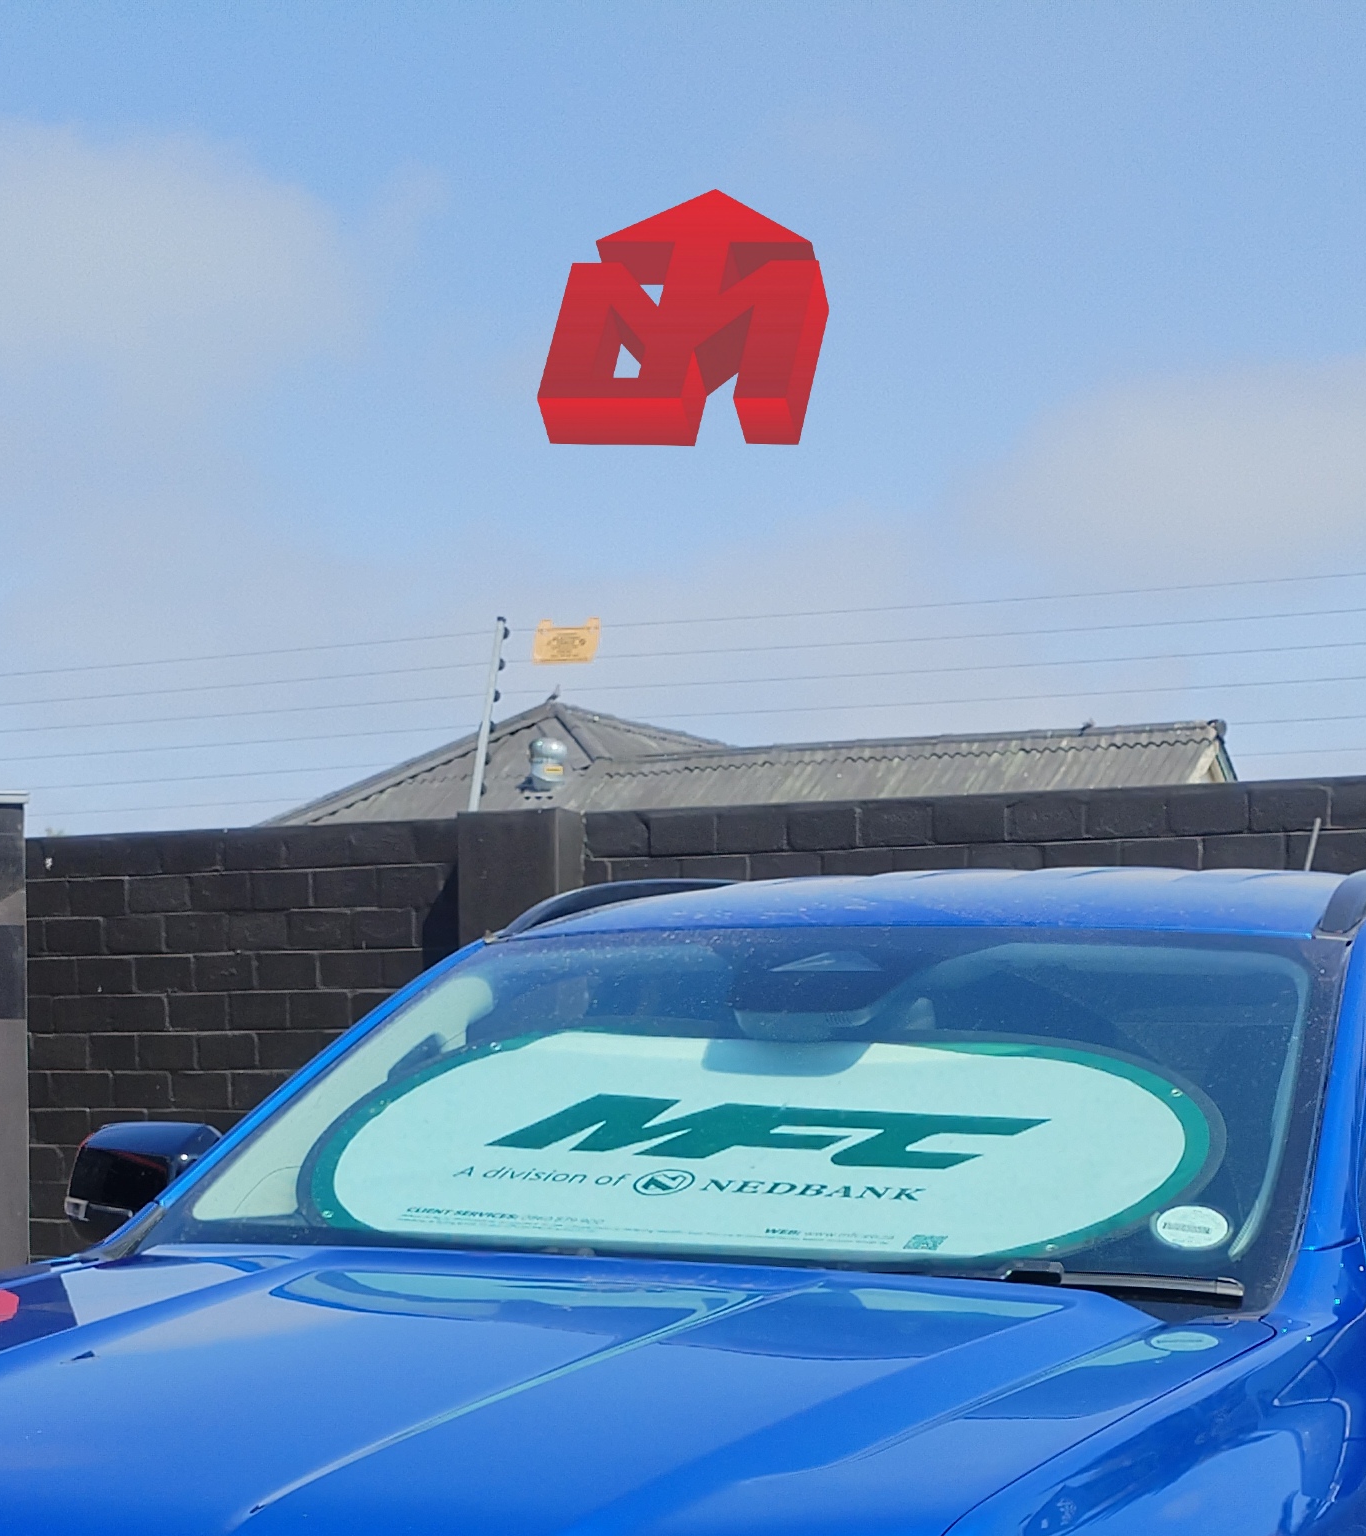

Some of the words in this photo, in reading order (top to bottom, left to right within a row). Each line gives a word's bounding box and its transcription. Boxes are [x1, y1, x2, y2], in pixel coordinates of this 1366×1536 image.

[486, 1093, 1051, 1170] MFC
[453, 1166, 474, 1178] A
[483, 1166, 587, 1185] division
[594, 1173, 632, 1188] of
[699, 1178, 927, 1202] NEDBANK
